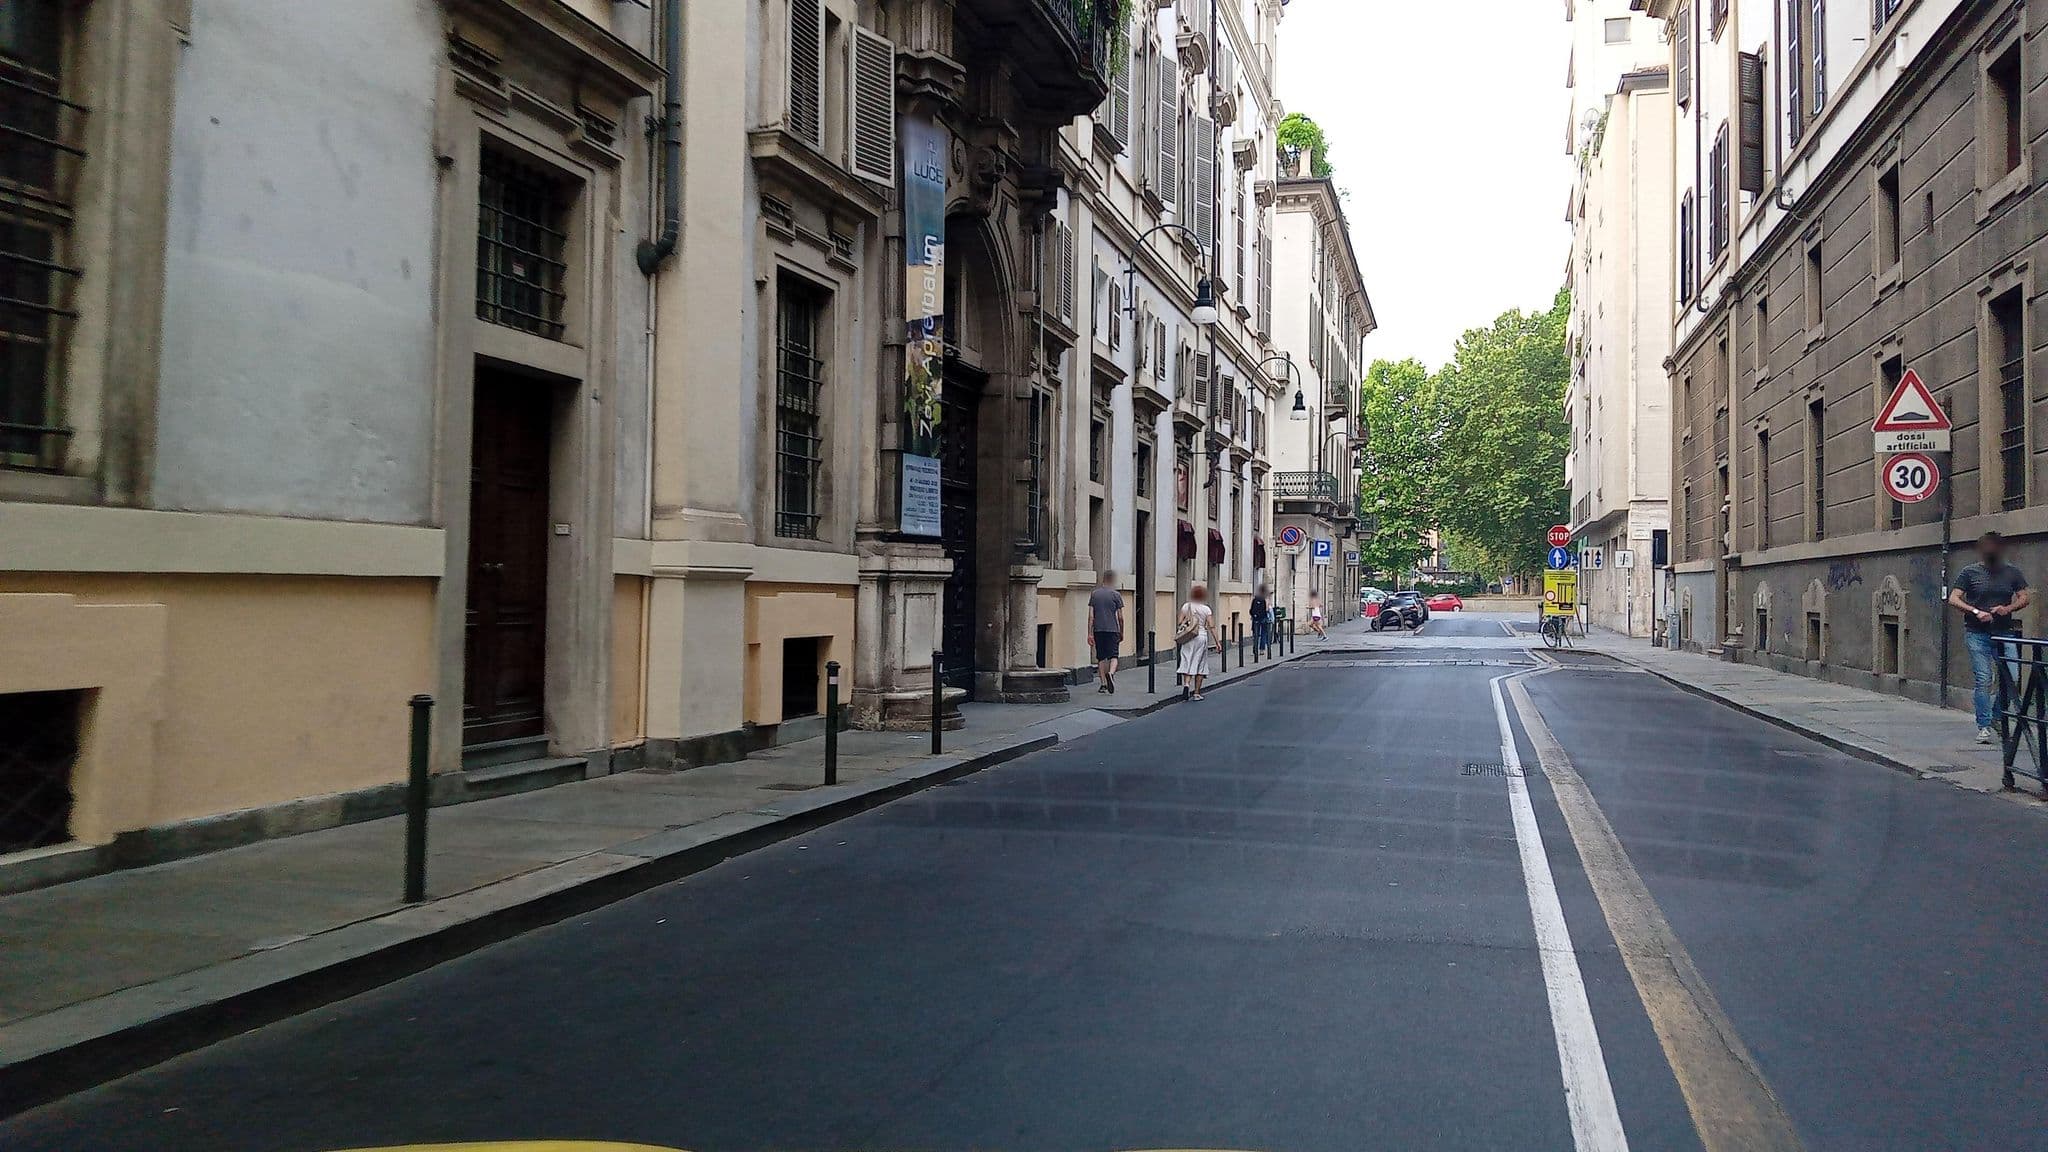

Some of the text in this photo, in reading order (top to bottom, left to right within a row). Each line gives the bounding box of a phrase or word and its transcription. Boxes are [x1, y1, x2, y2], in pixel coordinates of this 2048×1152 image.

[914, 161, 943, 184] LUCE
[1897, 432, 1925, 441] dossi
[1887, 442, 1936, 451] artificiali
[1896, 466, 1926, 489] 30
[1550, 532, 1569, 541] STOP
[1317, 542, 1328, 555] P
